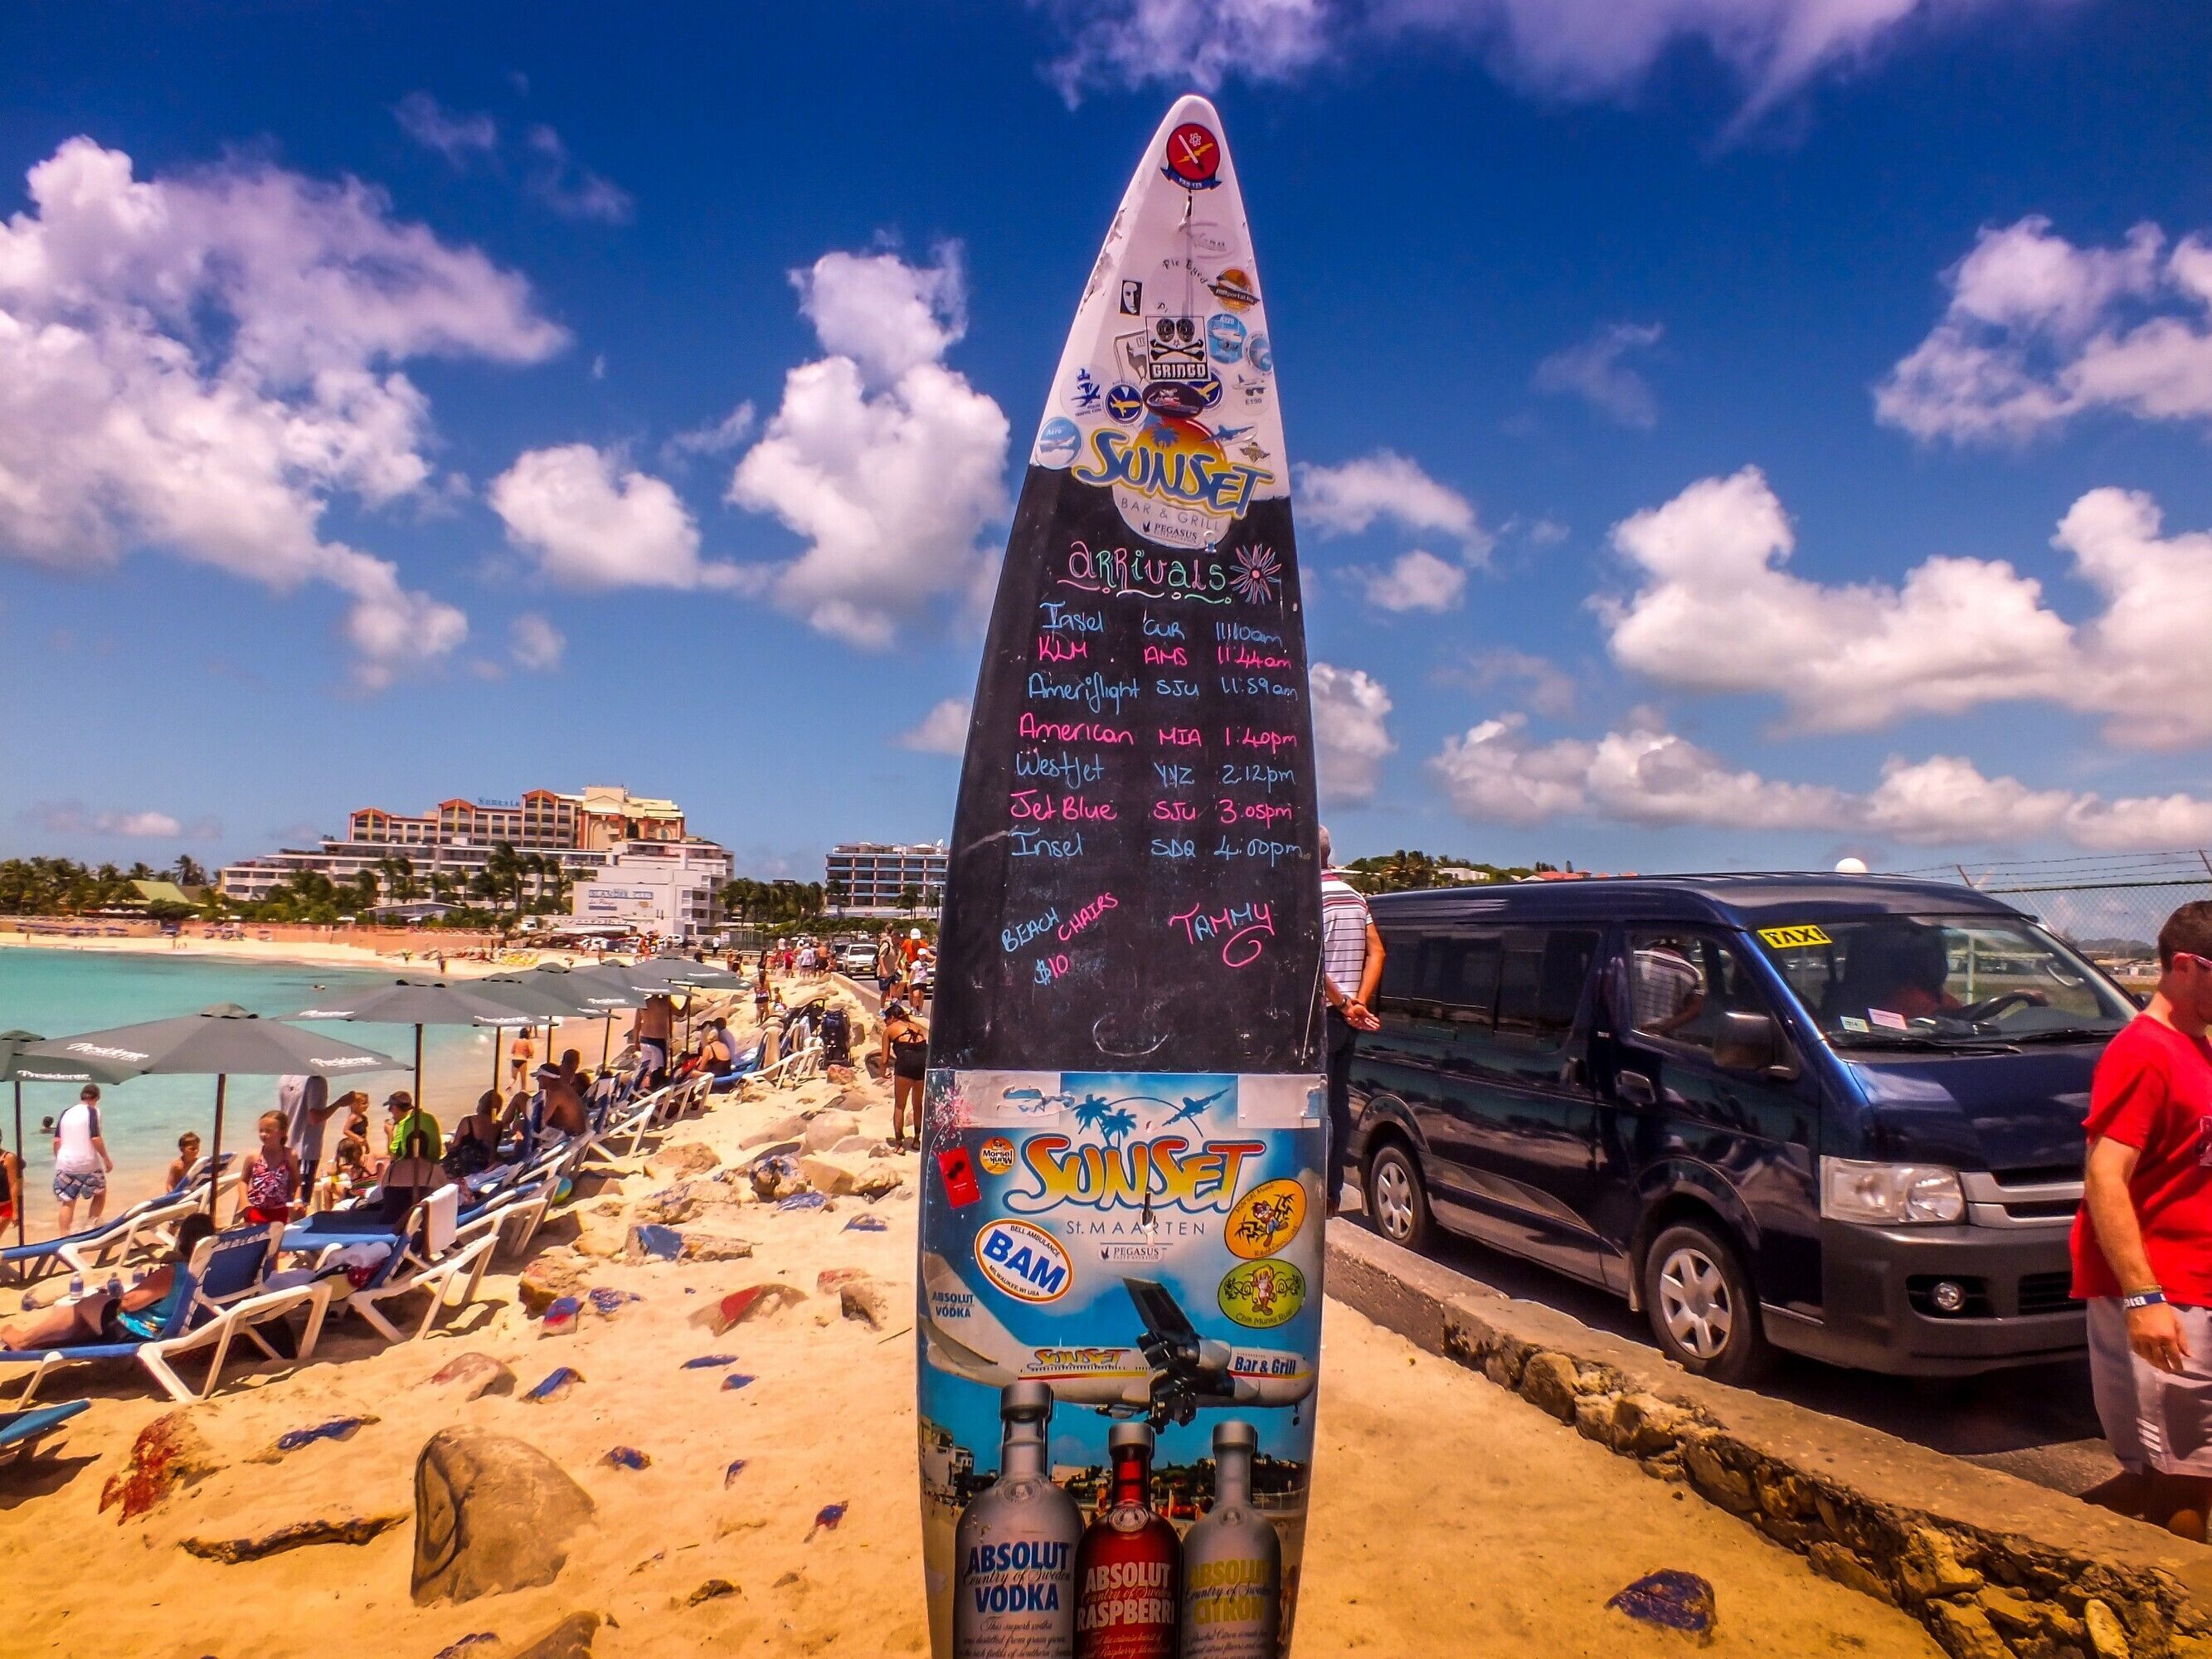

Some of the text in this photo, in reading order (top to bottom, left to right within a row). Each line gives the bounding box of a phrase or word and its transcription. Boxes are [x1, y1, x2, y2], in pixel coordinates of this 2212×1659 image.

[1152, 363, 1207, 378] GRINGO
[1072, 429, 1276, 519] SUNSET
[1121, 498, 1220, 532] BAR & GRILL
[1155, 523, 1197, 540] PEGASUS
[1038, 635, 1088, 662] KLM
[1144, 646, 1188, 666] AMS
[1028, 672, 1140, 713] Ameriflight
[1221, 676, 1298, 701] 11:59am
[1019, 712, 1298, 754] American MIA 1:40pm
[1222, 764, 1296, 794] 2:12pm
[1218, 798, 1292, 830] 3:05pm
[1011, 827, 1084, 857] Insel
[1213, 834, 1302, 868] 4:00pm
[1000, 892, 1119, 953] BEACH CHAIRS
[1169, 902, 1275, 967] TAMMY
[1764, 927, 1828, 945] TAXI
[1033, 954, 1070, 985] $10
[17, 1069, 91, 1080] Presidente
[1003, 1133, 1268, 1214] SUNSET
[1010, 1225, 1061, 1258] BELL AMBULANCE
[1066, 1220, 1204, 1236] St. MAARTEN
[983, 1228, 1067, 1295] BAM
[1114, 1247, 1159, 1256] PEGASUS
[932, 1292, 974, 1303] ABSOLUT
[936, 1306, 971, 1317] VODKA
[1027, 1348, 1130, 1370] SUNSET
[1234, 1355, 1296, 1375] Bar & Grill
[969, 1540, 1071, 1573] ABSOLUT
[1013, 1567, 1028, 1587] of
[1028, 1567, 1072, 1582] Sweden
[1085, 1561, 1171, 1593] ABSOLUT
[1190, 1559, 1270, 1588] ABSOLUT
[975, 1583, 1060, 1613] VODKA
[1194, 1596, 1266, 1626] CITRON
[1077, 1598, 1174, 1632] RASPBERRI
